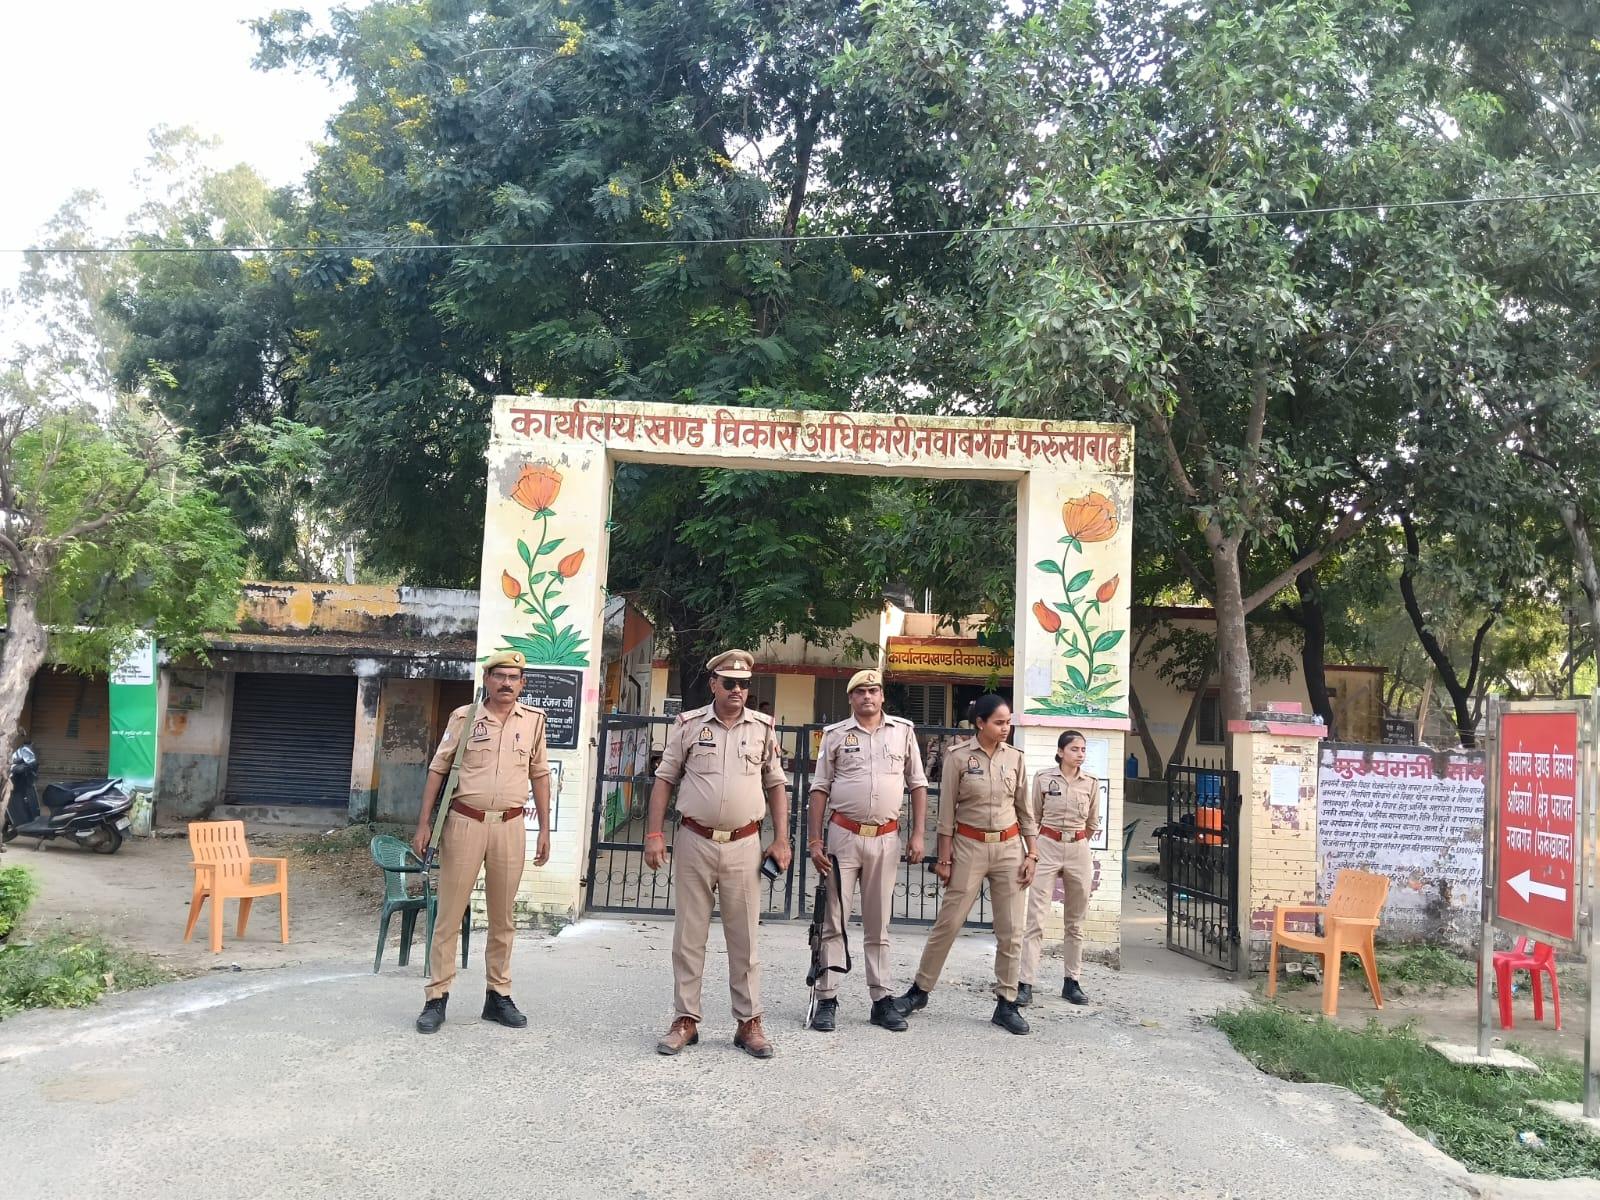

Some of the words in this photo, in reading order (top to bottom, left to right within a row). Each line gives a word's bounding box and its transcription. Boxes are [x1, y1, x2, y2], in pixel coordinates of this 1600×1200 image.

[510, 401, 637, 443] कार्यालय
[643, 416, 707, 447] खण्ड
[712, 409, 801, 452] विकास
[562, 696, 573, 708] जी
[1534, 753, 1550, 779] खण्ड
[1552, 744, 1573, 781] विकास
